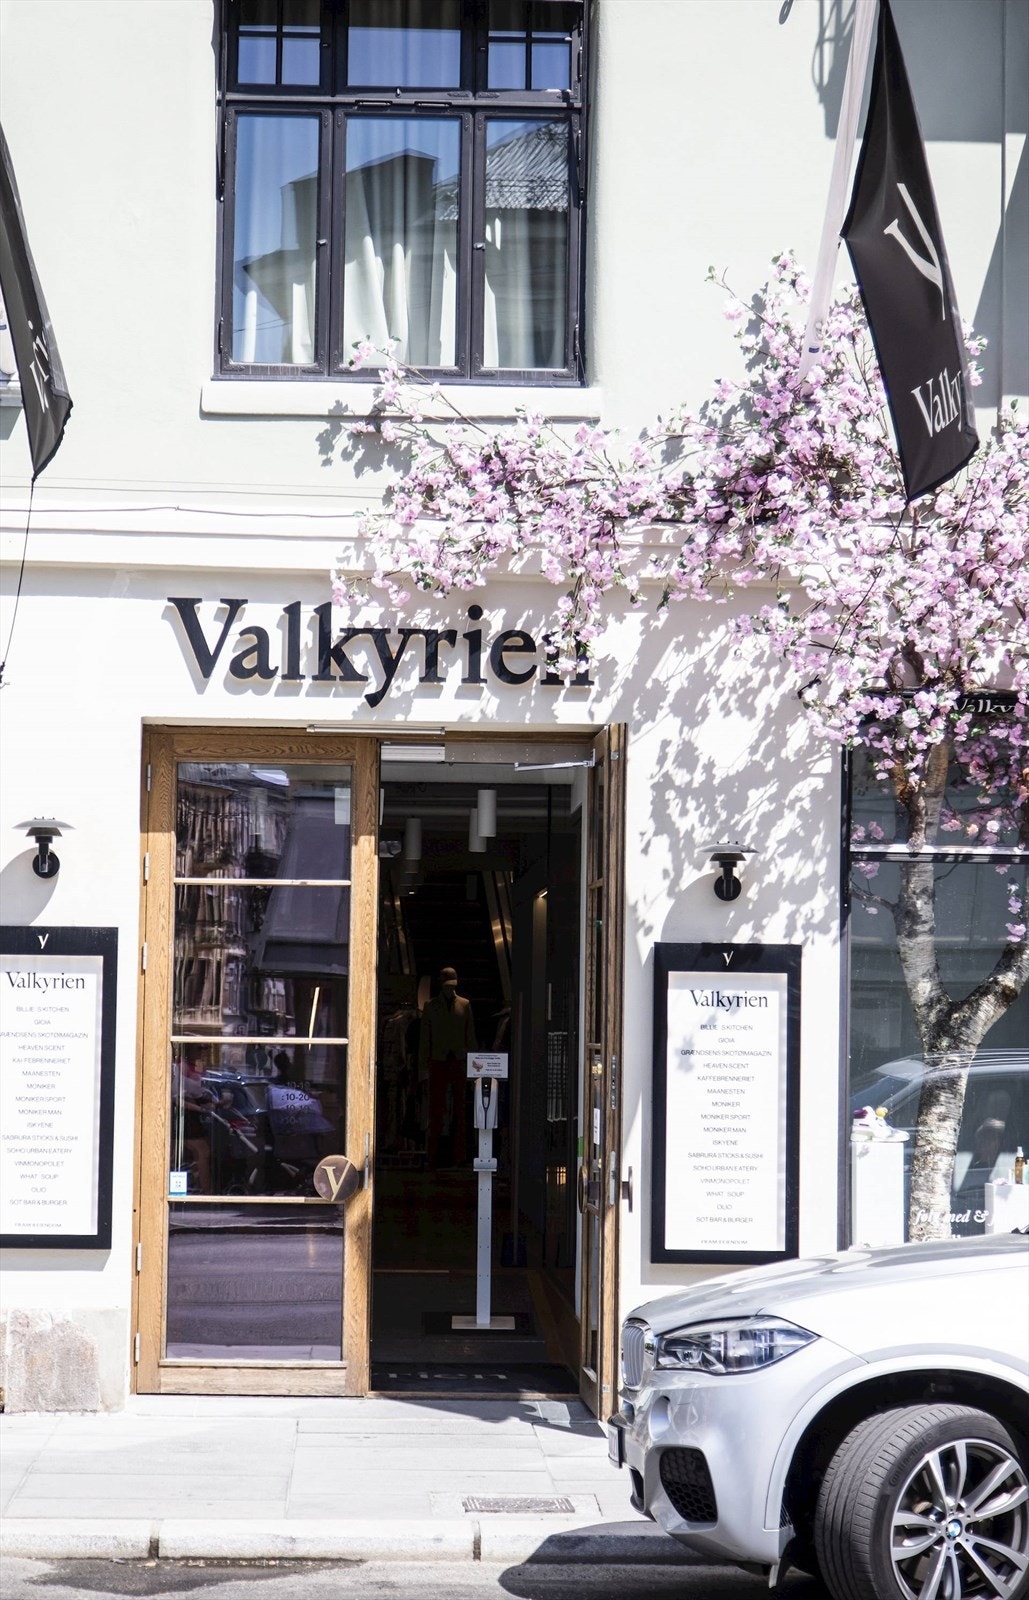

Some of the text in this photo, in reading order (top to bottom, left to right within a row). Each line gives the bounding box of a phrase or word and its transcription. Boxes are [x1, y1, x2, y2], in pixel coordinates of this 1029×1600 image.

[167, 596, 595, 710] Valkyrien
[6, 971, 86, 994] Valkyrien
[689, 989, 768, 1012] Valkyrien
[14, 1160, 65, 1168] VINMONOPOLET
